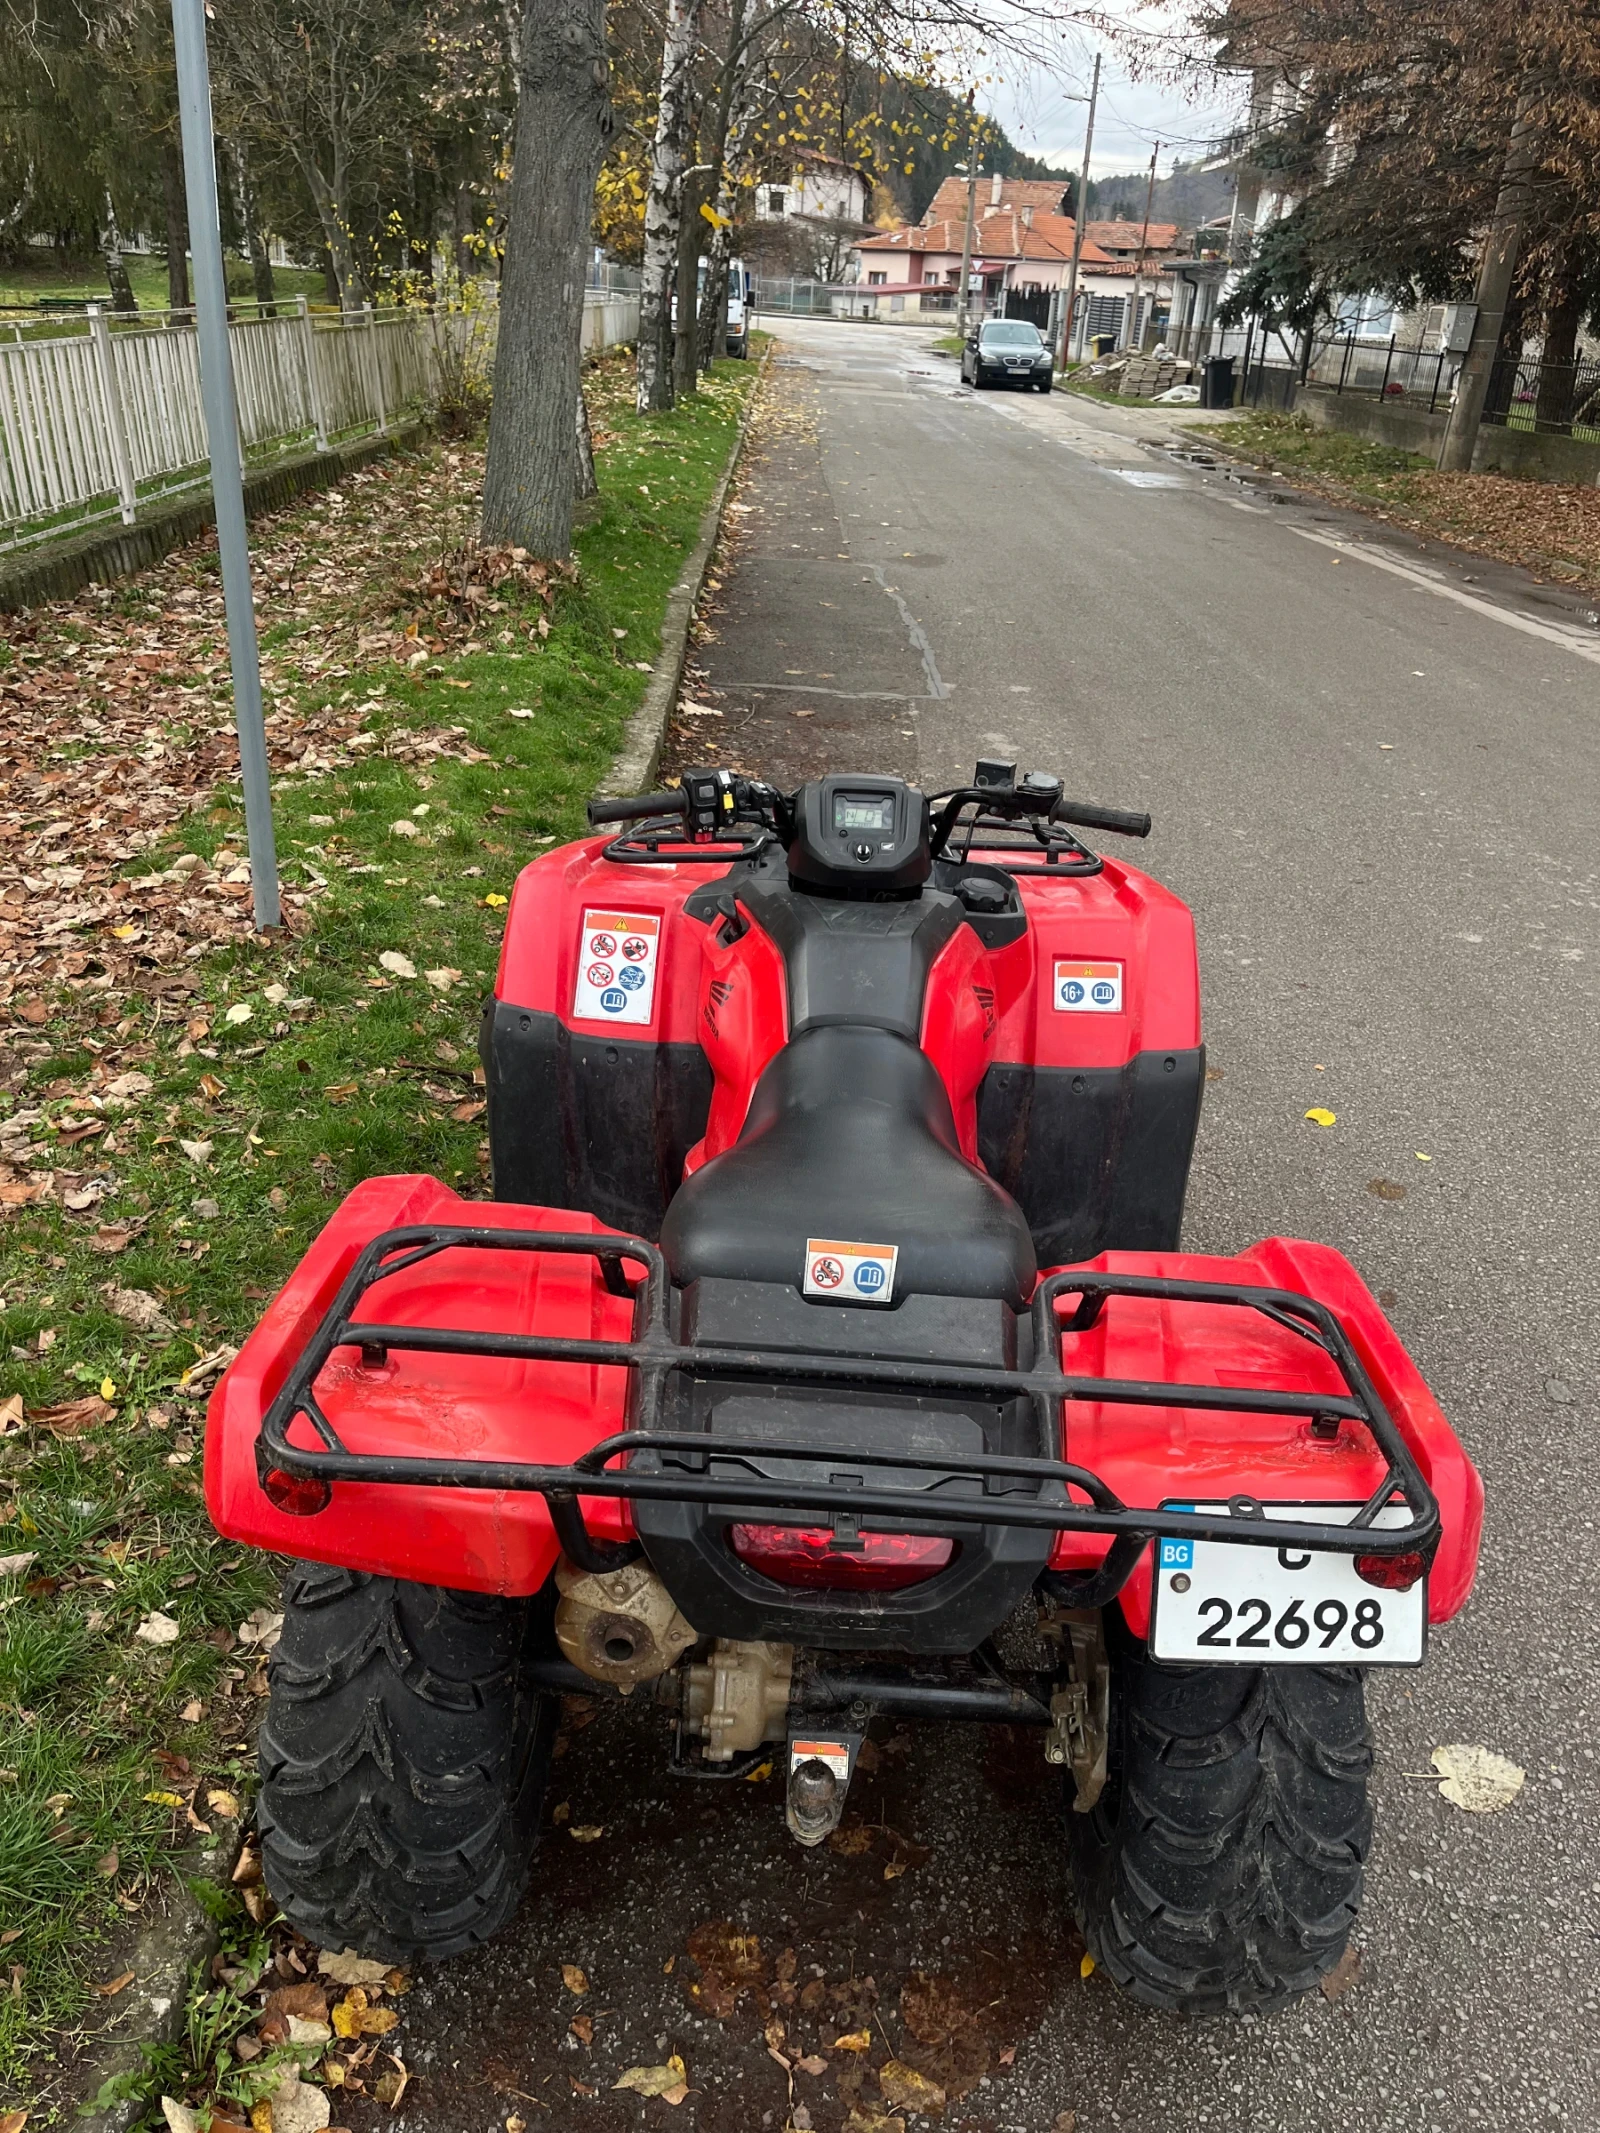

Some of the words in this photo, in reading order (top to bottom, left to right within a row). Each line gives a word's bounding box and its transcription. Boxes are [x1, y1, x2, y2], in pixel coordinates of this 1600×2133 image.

[1063, 985, 1082, 1000] 16+
[1163, 1545, 1188, 1562] BG
[1197, 1597, 1385, 1649] 22698
